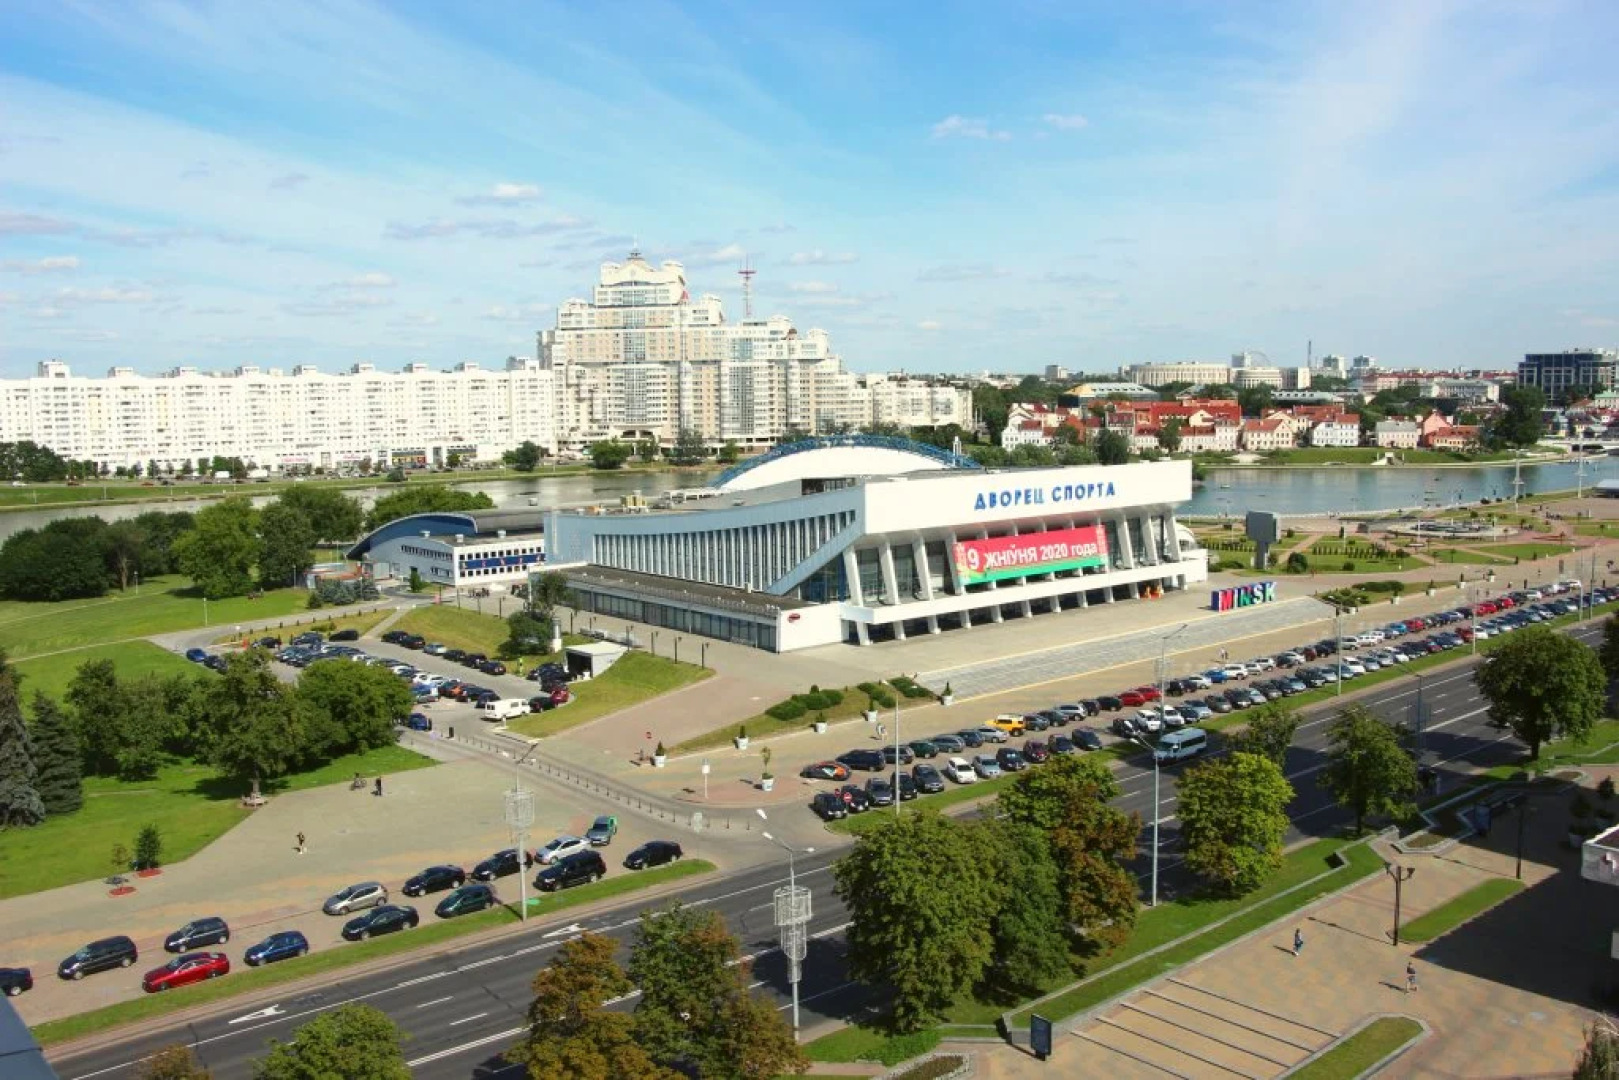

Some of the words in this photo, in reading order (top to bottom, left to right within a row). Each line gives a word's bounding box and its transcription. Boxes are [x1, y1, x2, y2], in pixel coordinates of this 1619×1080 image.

[974, 488, 1045, 510] ДВОРЕЦ
[1051, 482, 1115, 502] СПОРТА
[967, 548, 980, 570] 9
[1039, 543, 1068, 561] 2020
[1071, 543, 1098, 557] года
[1216, 581, 1278, 613] MINSK
